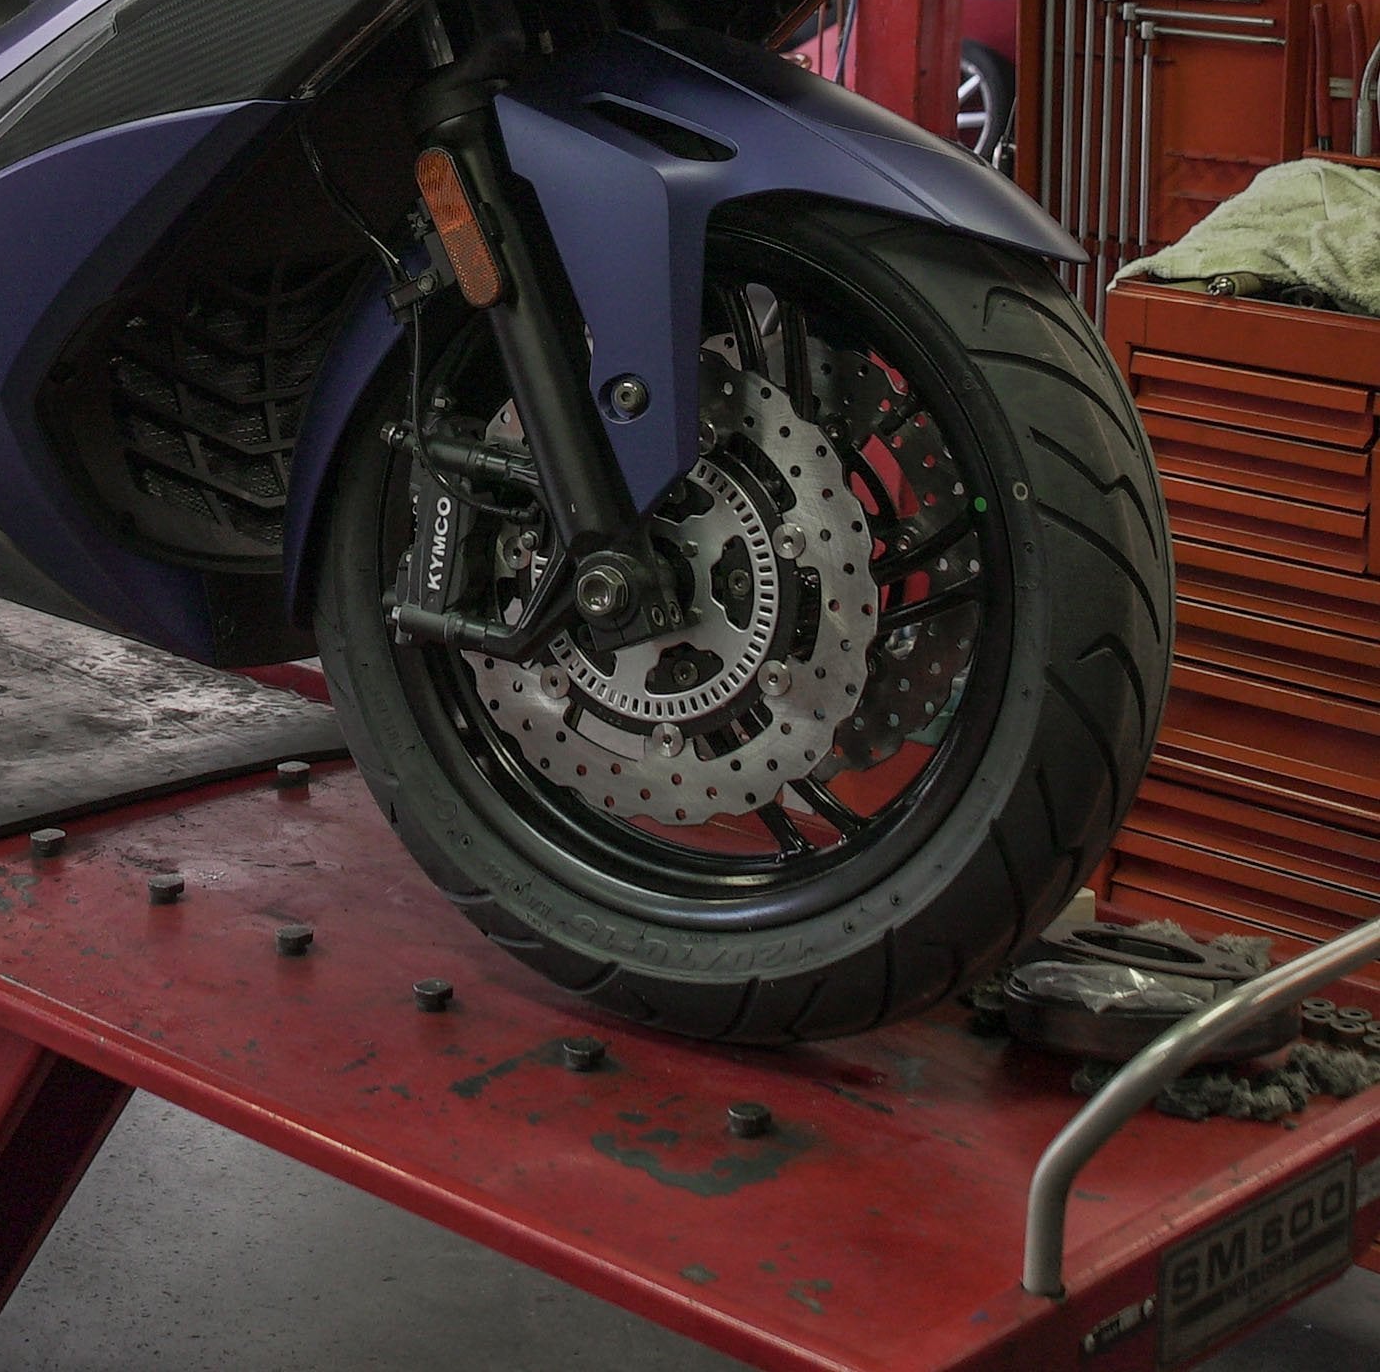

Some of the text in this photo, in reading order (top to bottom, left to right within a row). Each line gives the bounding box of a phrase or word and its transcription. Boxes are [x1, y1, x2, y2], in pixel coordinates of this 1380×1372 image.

[427, 496, 452, 591] KYMCO
[1171, 1230, 1247, 1303] SM
[1261, 1182, 1345, 1252] 600
